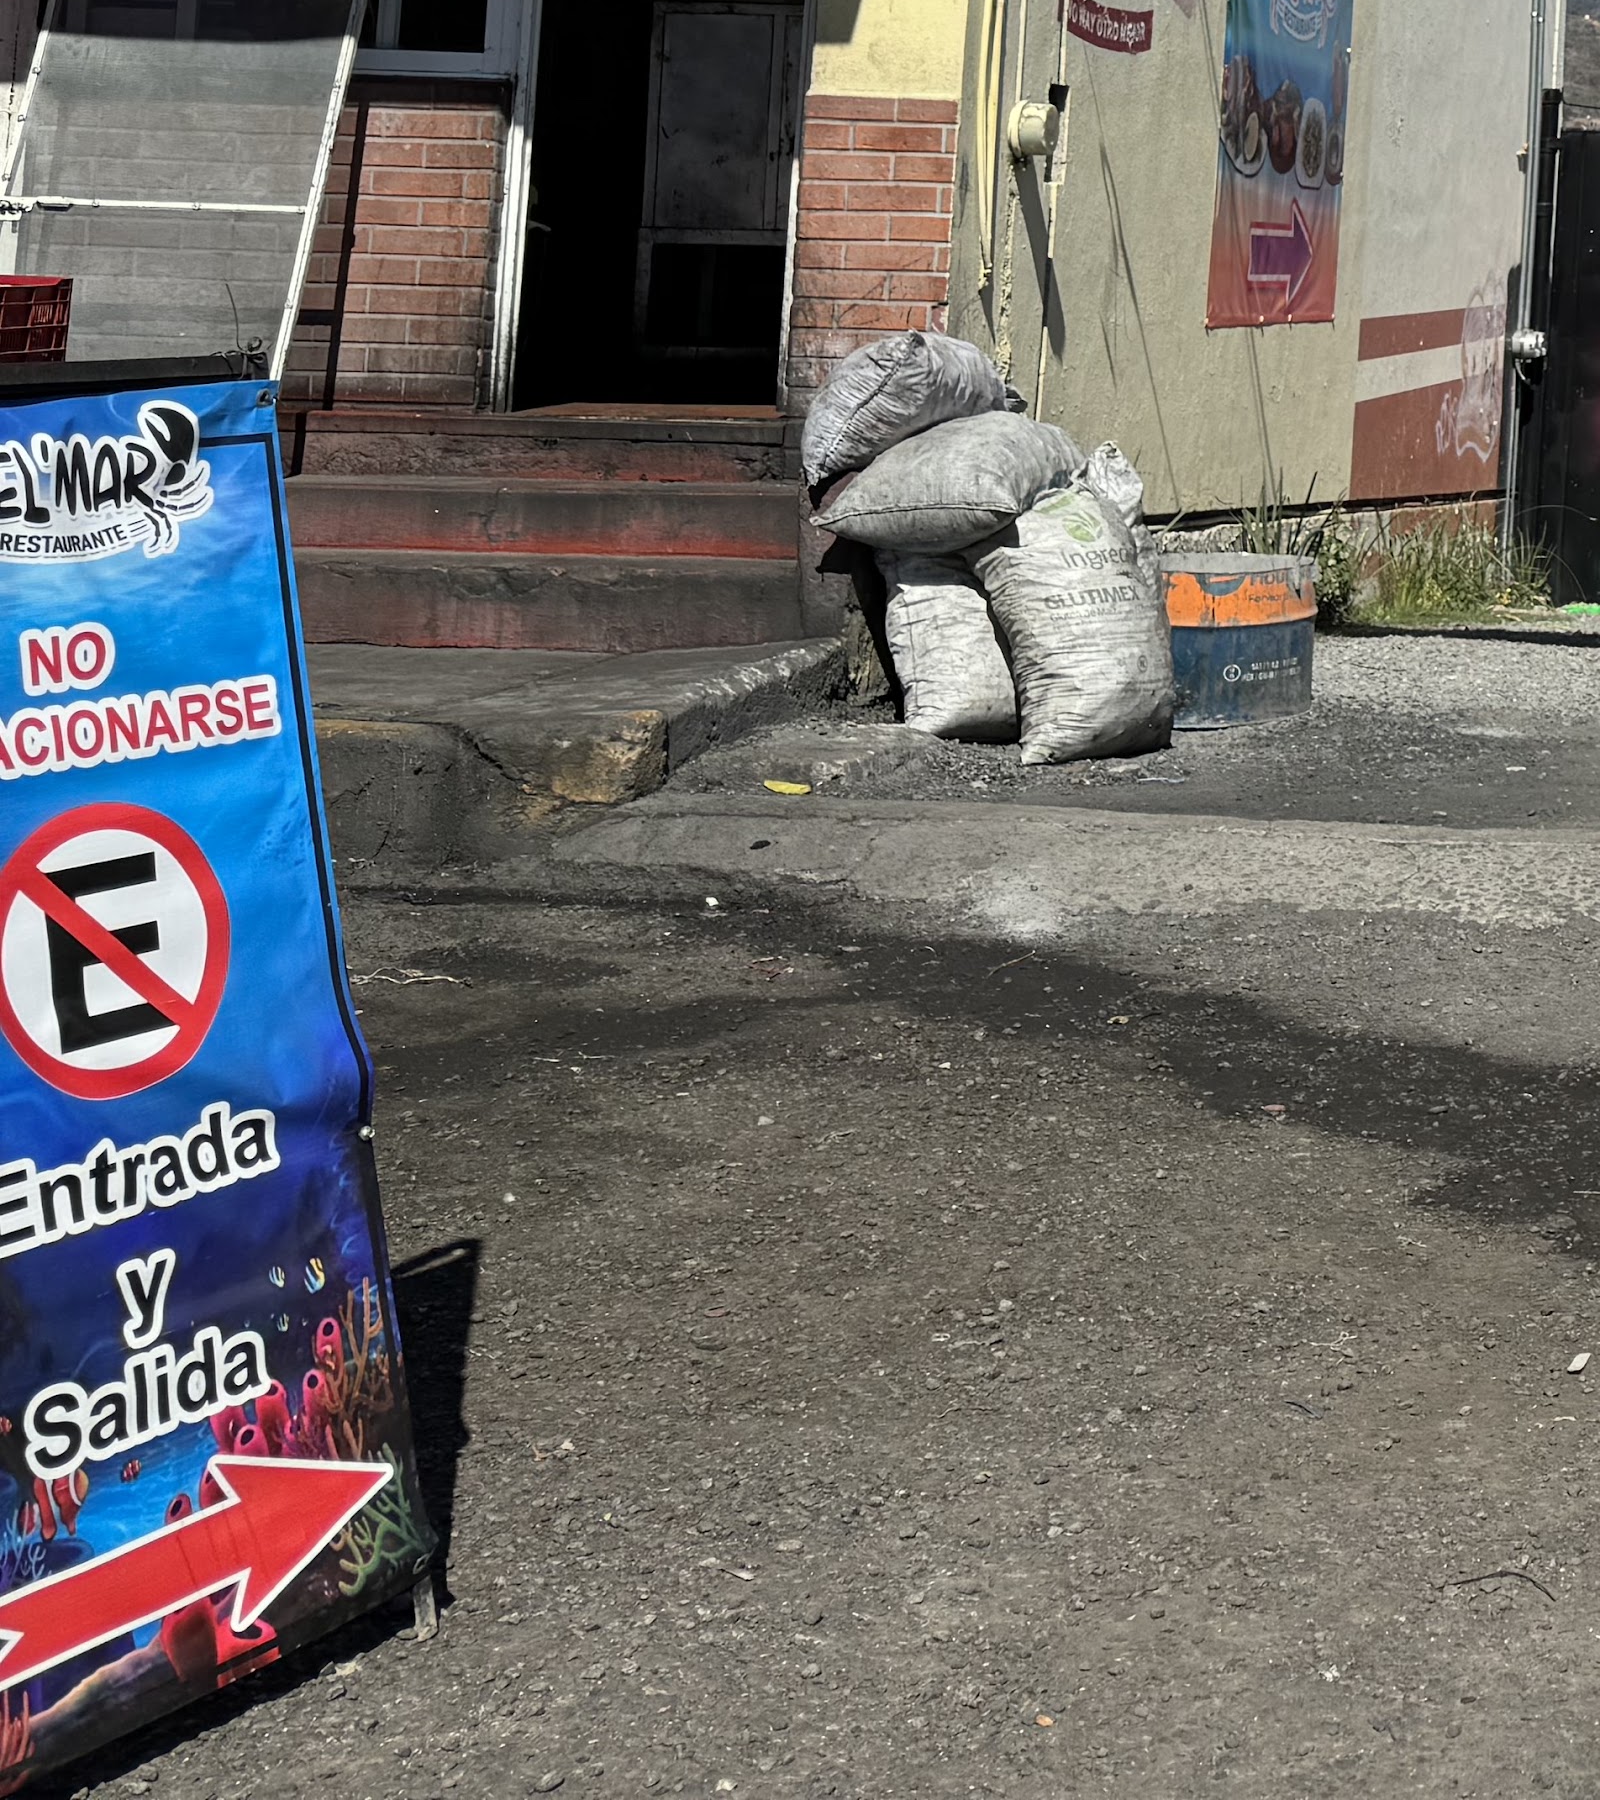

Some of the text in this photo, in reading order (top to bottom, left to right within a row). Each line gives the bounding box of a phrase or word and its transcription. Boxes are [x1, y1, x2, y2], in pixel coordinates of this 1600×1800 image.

[0, 524, 127, 554] RESTAURANTE
[28, 631, 107, 686] NO
[0, 1111, 273, 1246] Entrada
[120, 1254, 170, 1340] y
[31, 1337, 262, 1474] Salida
